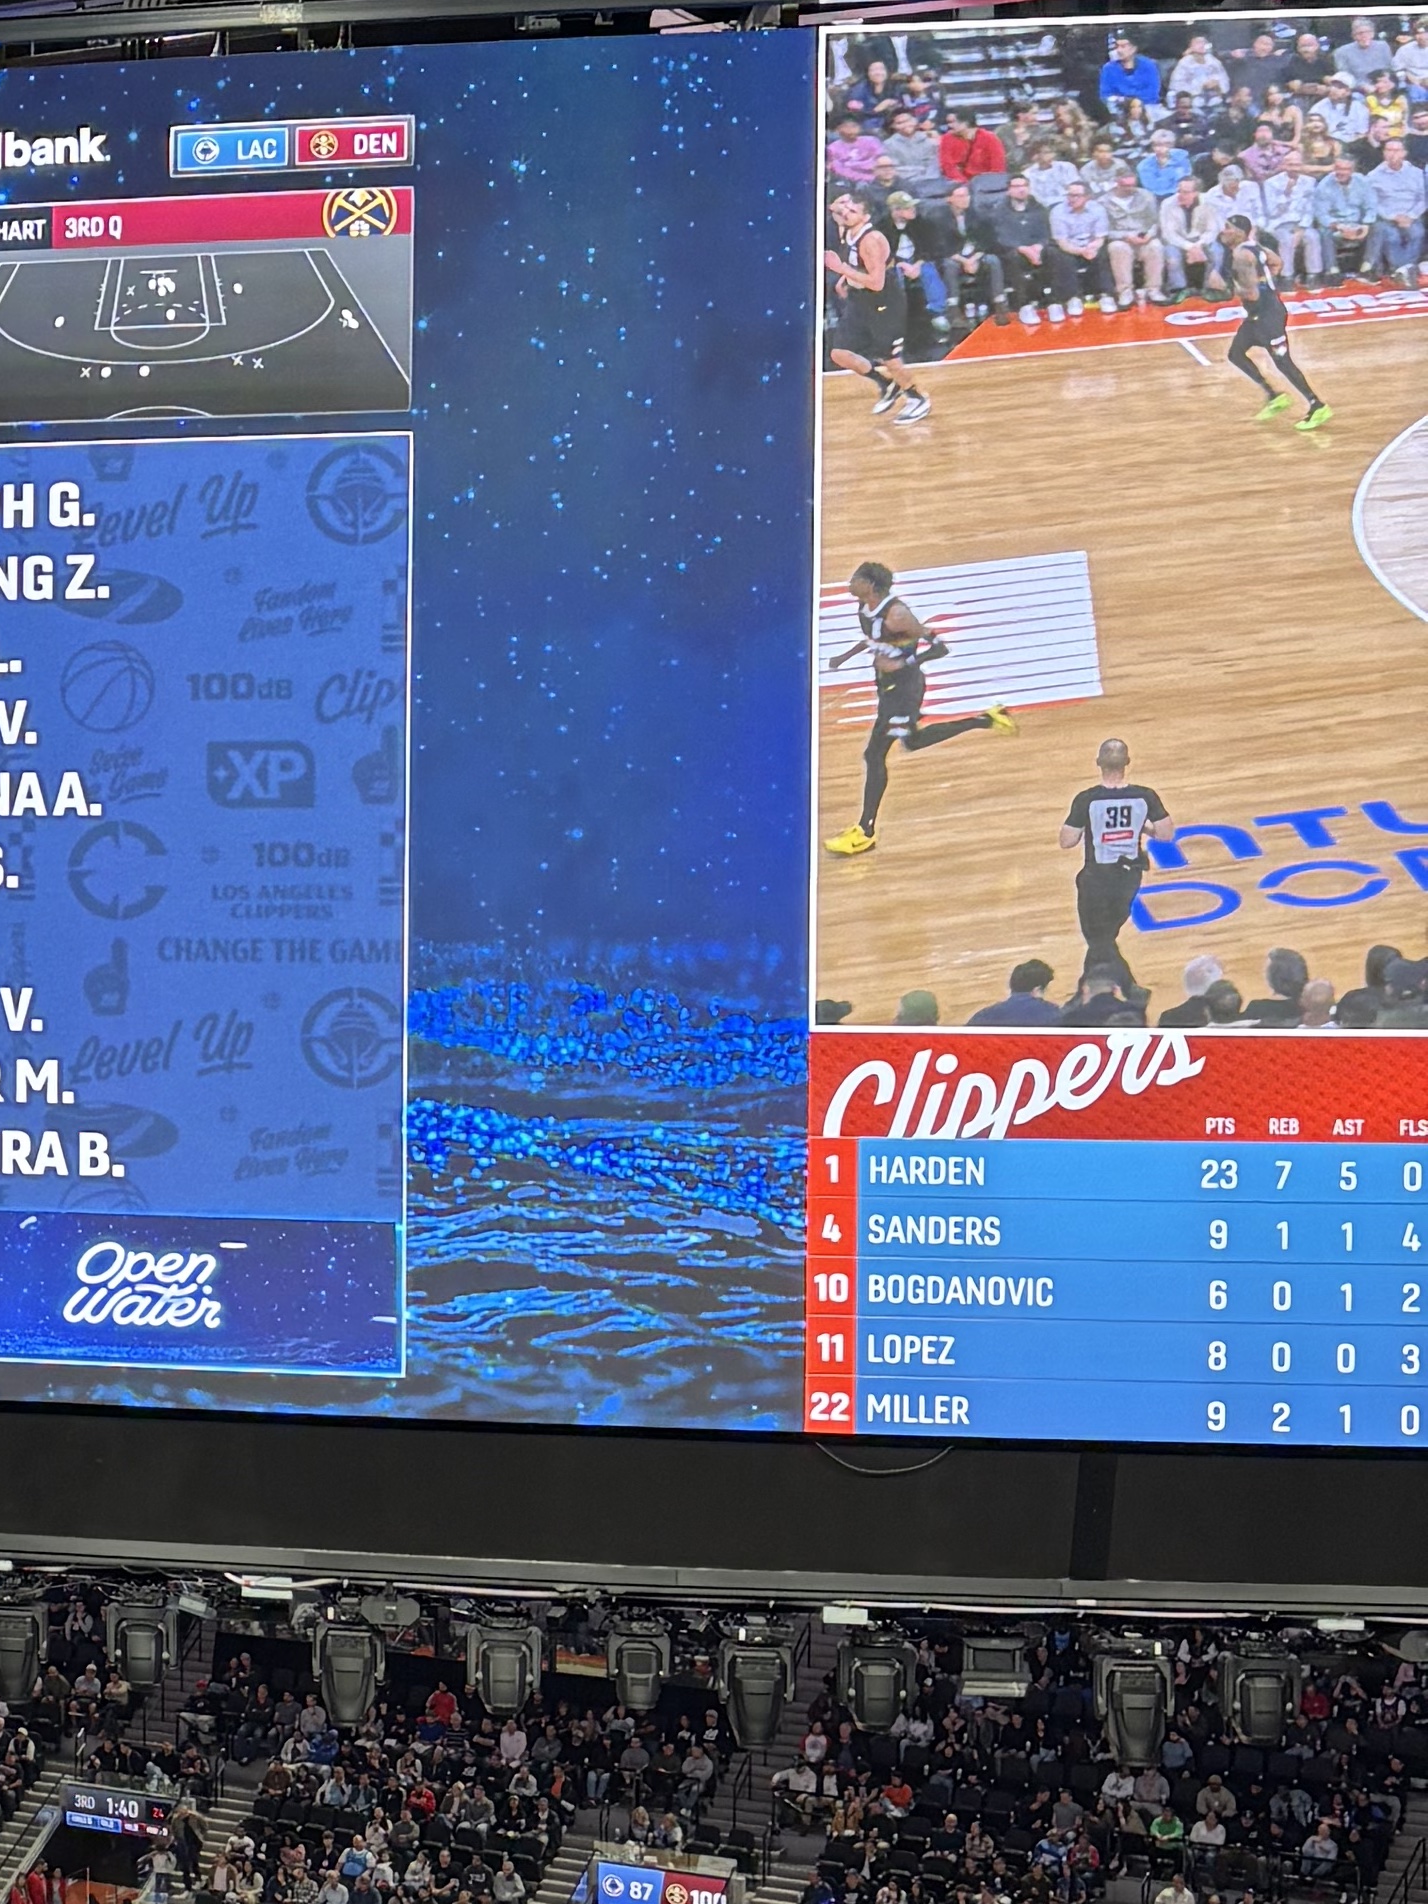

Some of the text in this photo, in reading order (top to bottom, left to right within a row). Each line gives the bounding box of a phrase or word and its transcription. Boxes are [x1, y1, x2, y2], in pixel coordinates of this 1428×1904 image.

[237, 130, 398, 161] LAC DEN
[64, 215, 103, 241] 3RD
[107, 213, 123, 242] Q
[49, 482, 95, 527] G.
[65, 554, 109, 600] Z.
[51, 771, 102, 817] A.
[1105, 805, 1132, 828] 39
[5, 987, 43, 1032] V.
[16, 1059, 75, 1104] M.
[822, 1033, 1206, 1140] Clippers
[1205, 1117, 1364, 1136] PTS REB AST
[79, 1132, 124, 1178] B.
[869, 1156, 1238, 1189] HARDEN 23
[868, 1215, 1001, 1248] SANDERS
[62, 1242, 220, 1330] Open Water
[867, 1275, 1054, 1307] BOGDANOVIC
[866, 1334, 956, 1365] LOPEZ
[810, 1391, 970, 1426] 22 MILLER
[106, 1797, 138, 1818] 1:40
[629, 1881, 653, 1901] 87
